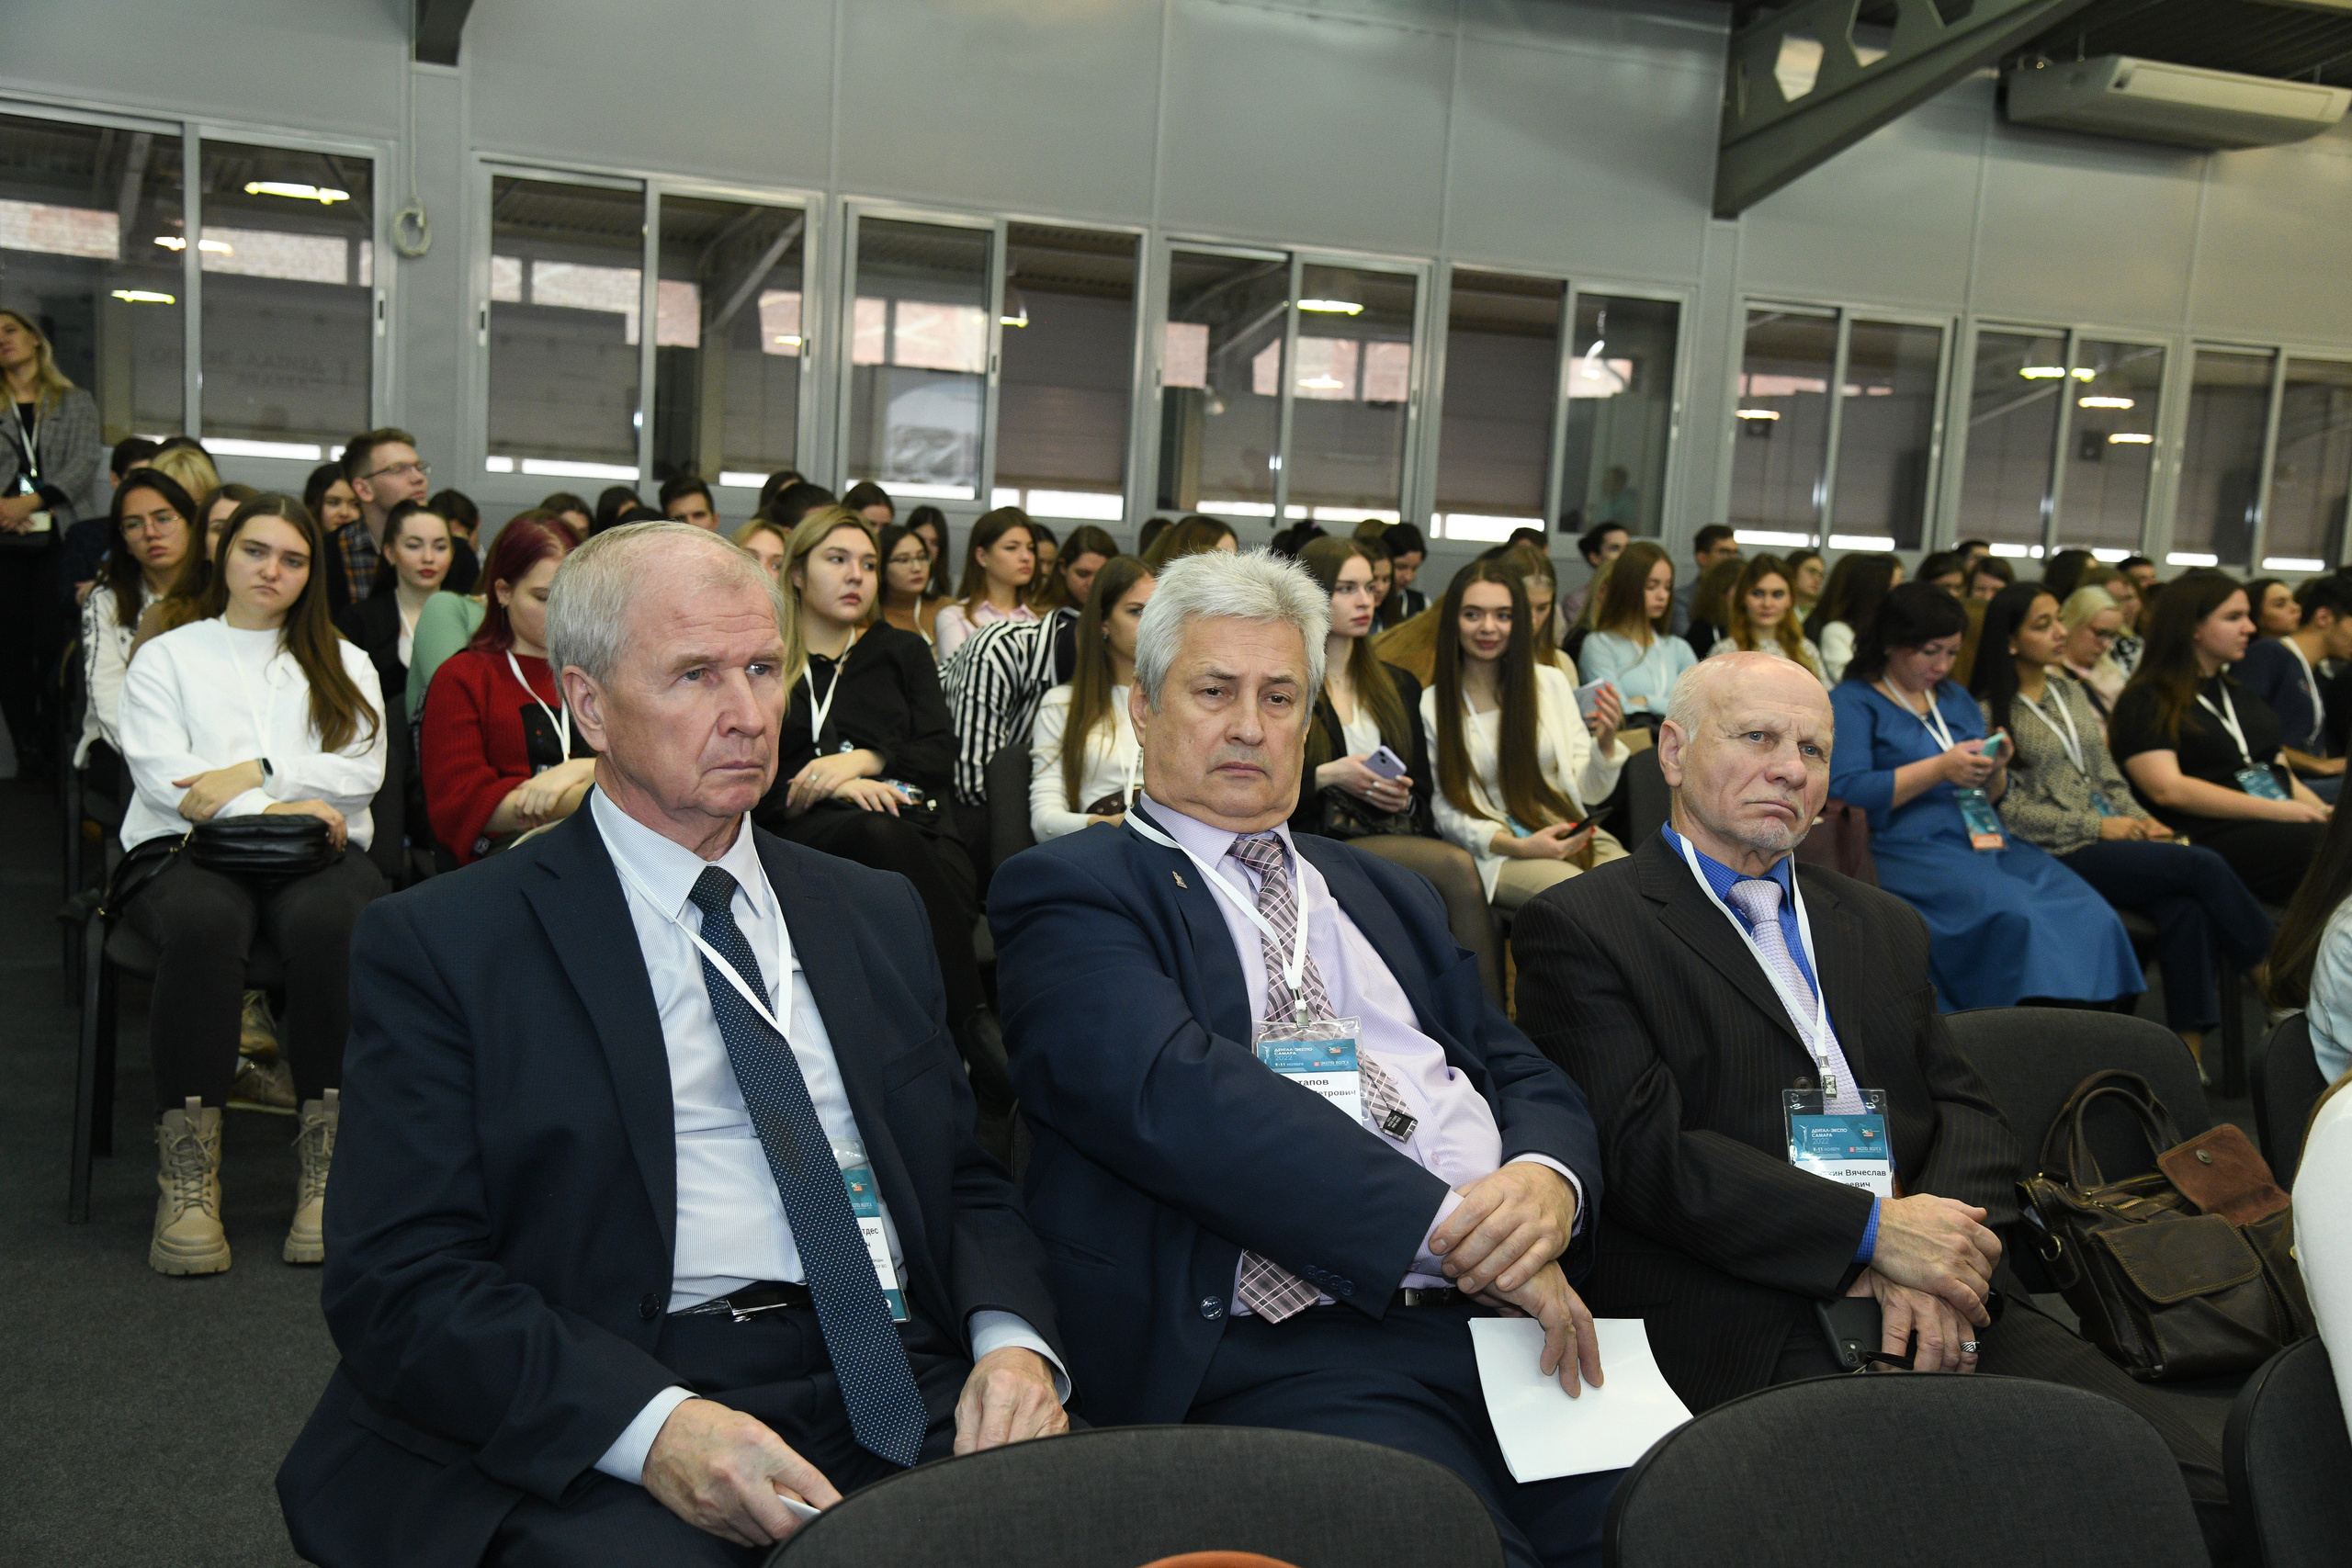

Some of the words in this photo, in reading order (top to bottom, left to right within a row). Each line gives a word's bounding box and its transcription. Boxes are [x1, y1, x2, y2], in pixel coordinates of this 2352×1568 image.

[1297, 1078, 1329, 1087] тапов
[1315, 1089, 1357, 1098] етрович
[861, 1227, 879, 1236] тдес
